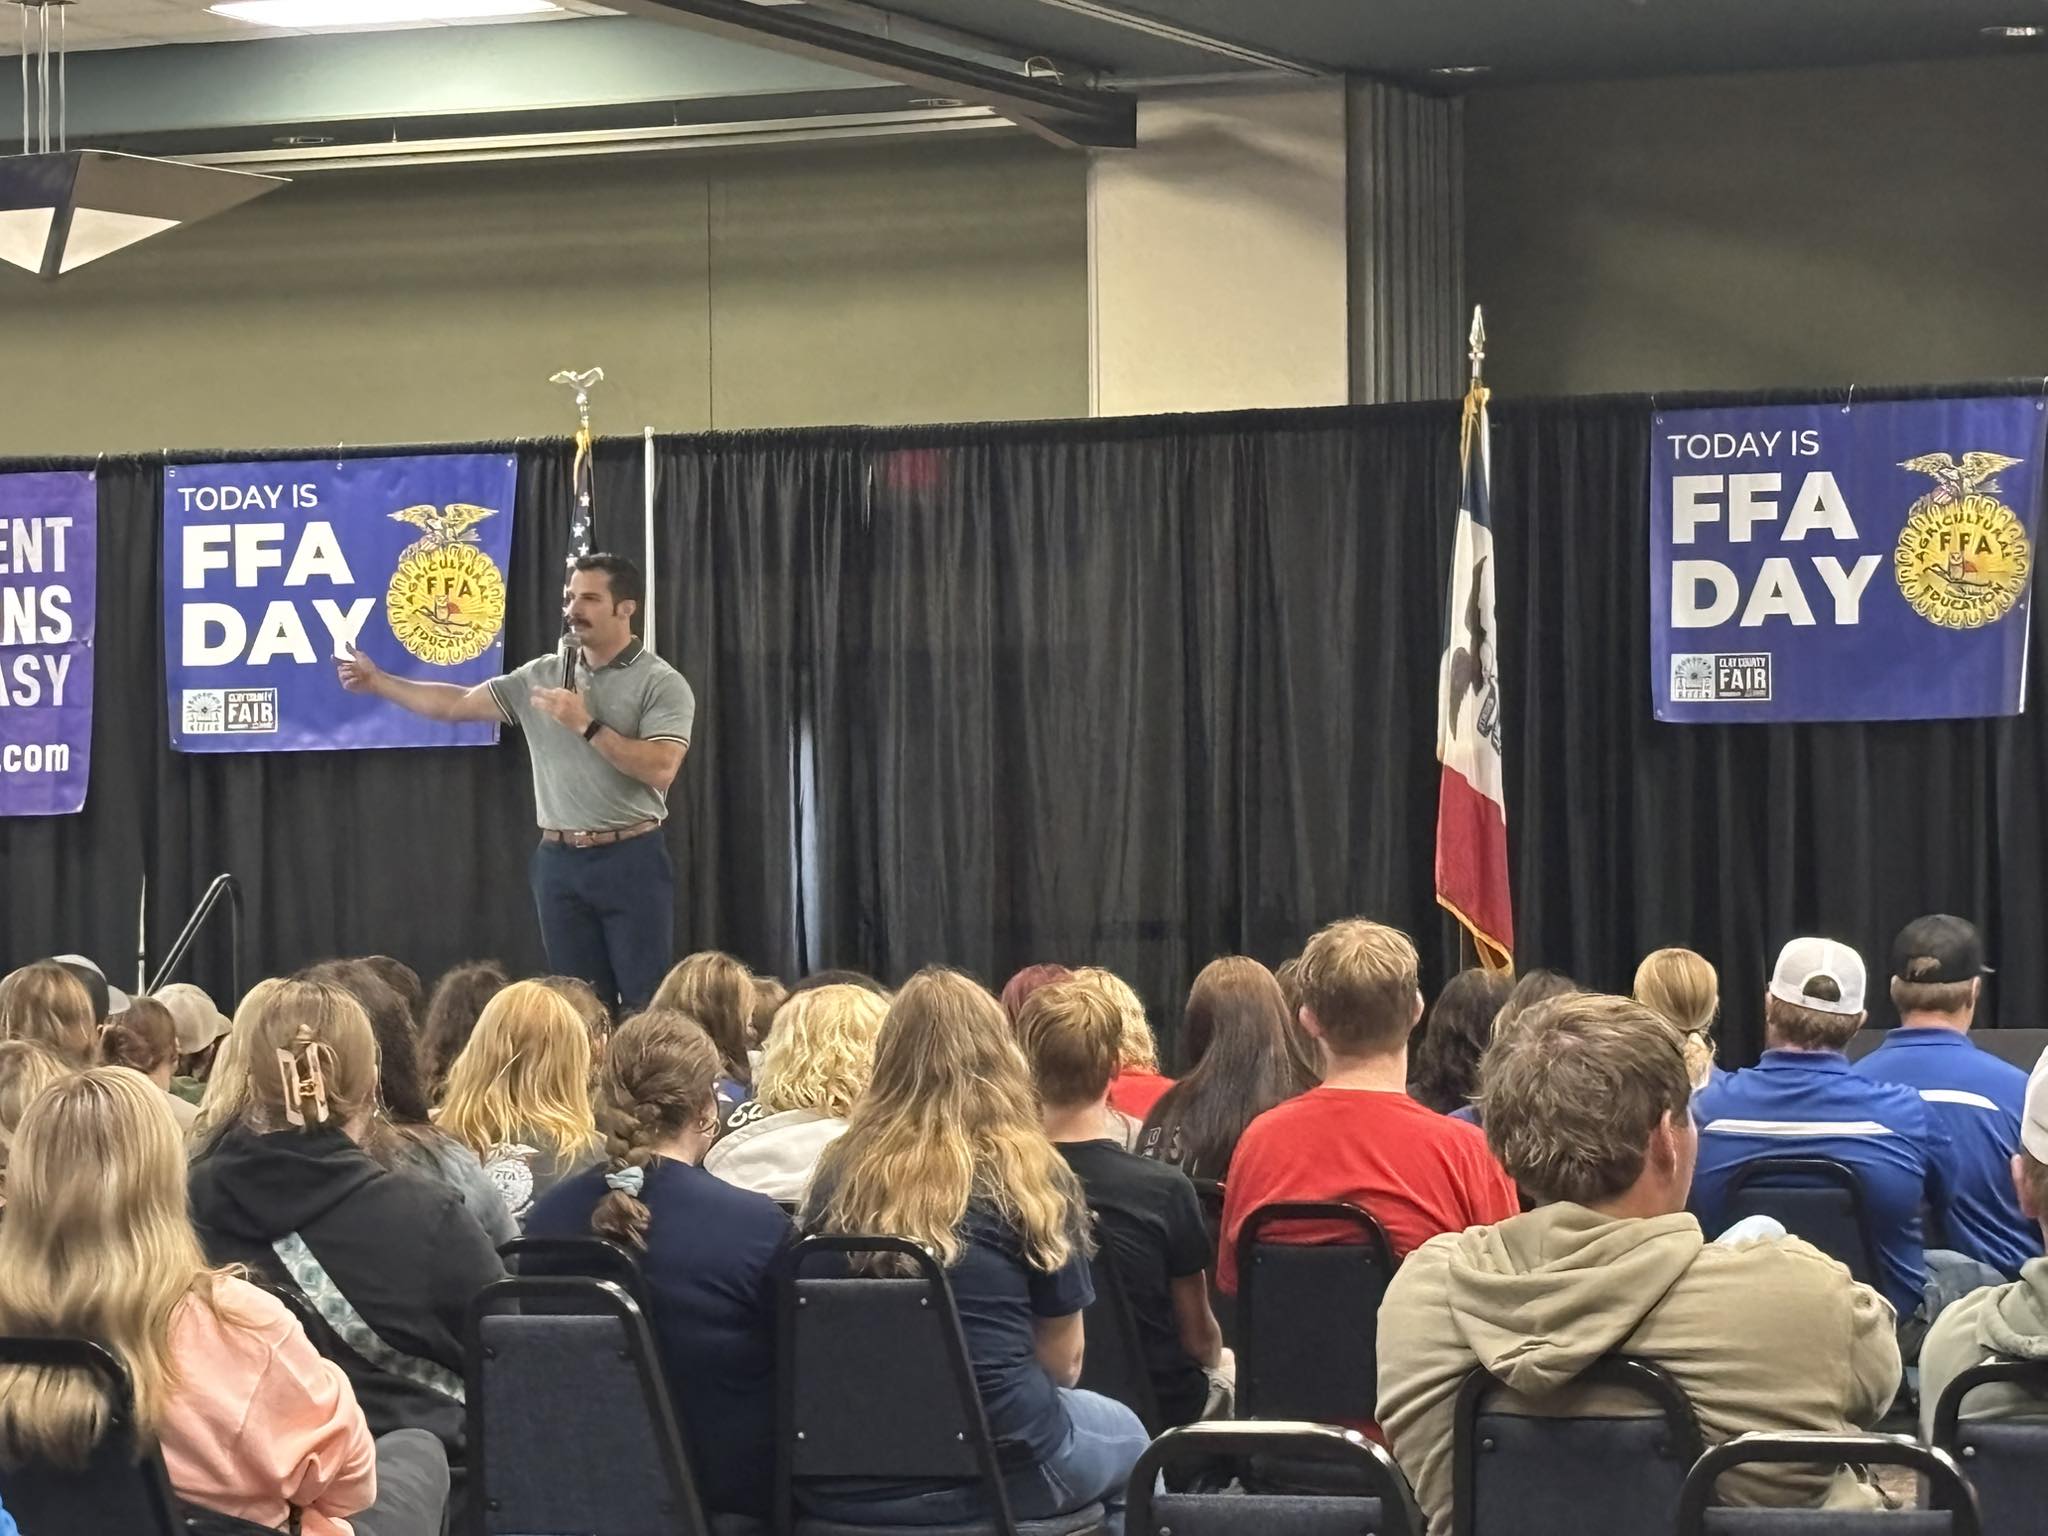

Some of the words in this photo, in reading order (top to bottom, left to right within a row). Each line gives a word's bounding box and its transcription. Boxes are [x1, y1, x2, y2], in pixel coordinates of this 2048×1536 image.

[1667, 431, 1782, 459] TODAY
[1792, 430, 1819, 456] IS
[177, 484, 283, 511] TODAY
[292, 483, 318, 508] IS
[1672, 471, 1859, 544] FFA
[1915, 513, 2012, 563] AGRICULTURAL
[1940, 531, 1993, 555] FFA
[182, 521, 356, 589] FFA
[426, 576, 473, 598] FFA
[1671, 554, 1883, 628] DAY
[1922, 583, 2004, 610] EDUCATION
[0, 585, 72, 645] NS
[182, 598, 377, 667] DAY
[413, 624, 483, 649] EDUCATION
[1720, 668, 1767, 690] FAIR
[228, 702, 274, 723] FAIR
[0, 743, 69, 773] com
